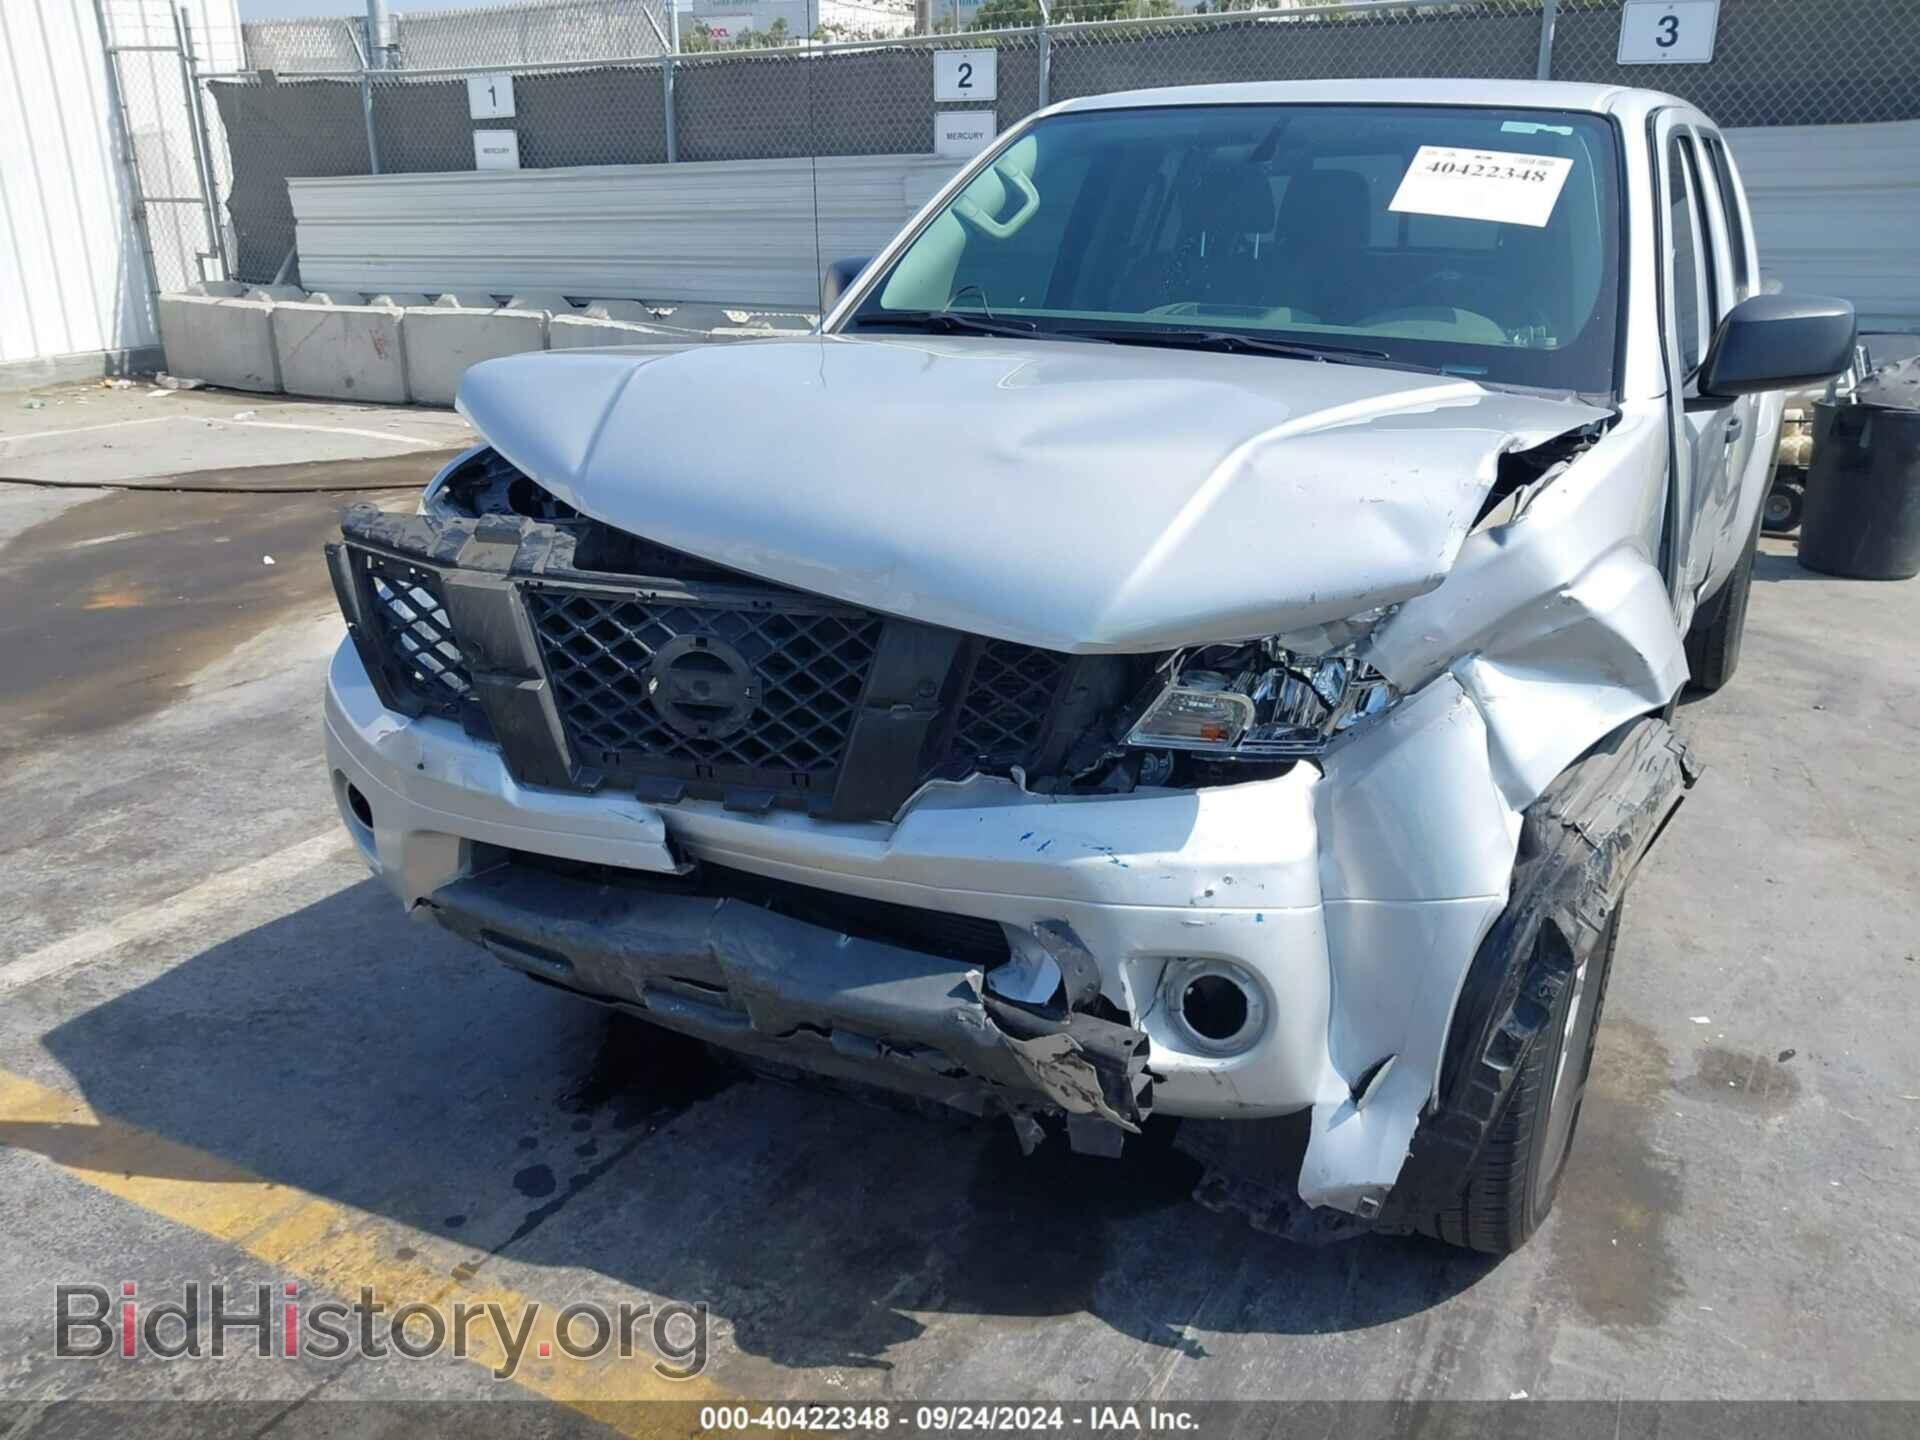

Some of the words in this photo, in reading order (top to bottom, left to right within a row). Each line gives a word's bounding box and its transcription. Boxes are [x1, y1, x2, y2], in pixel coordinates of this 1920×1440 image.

[1656, 15, 1679, 47] 3
[958, 63, 972, 88] 2
[487, 85, 496, 106] 1
[946, 132, 984, 140] MERCURY
[1425, 161, 1547, 182] 40422348
